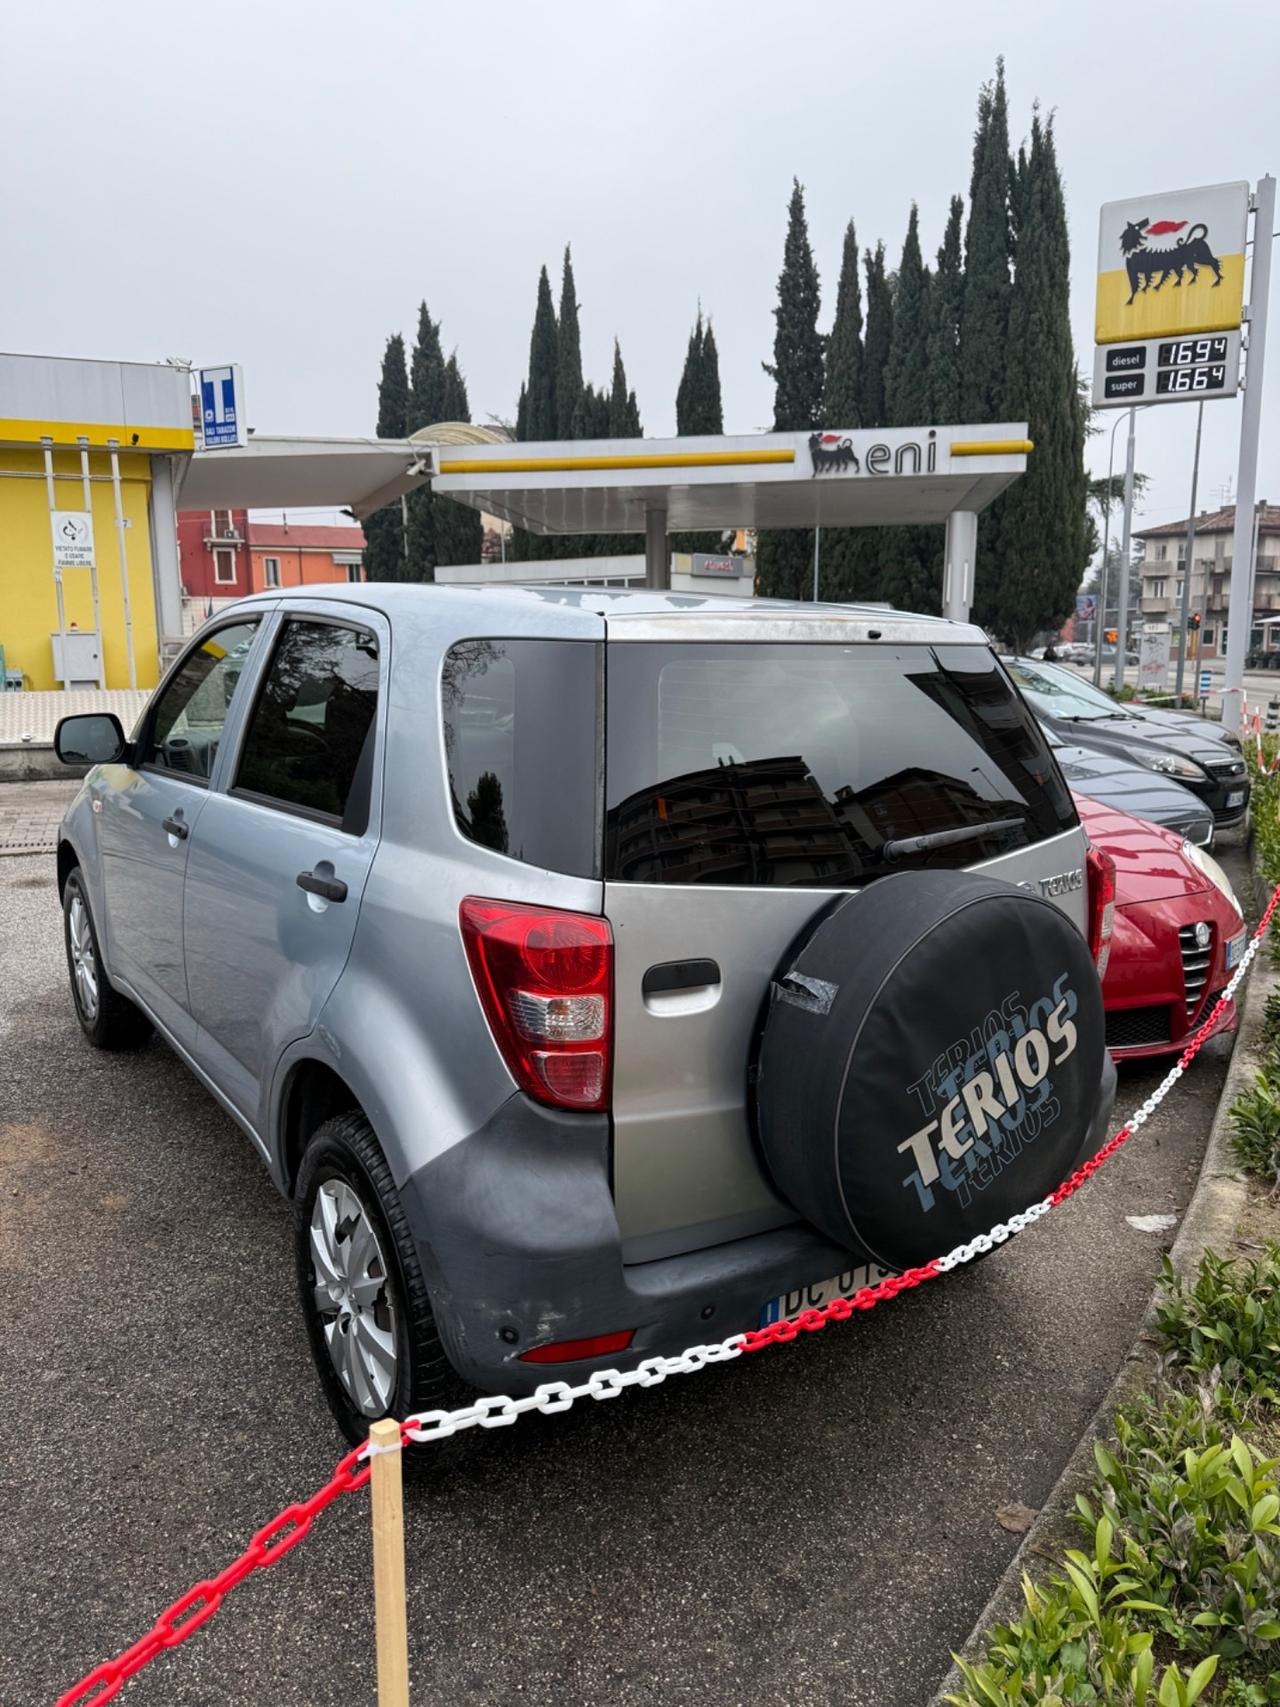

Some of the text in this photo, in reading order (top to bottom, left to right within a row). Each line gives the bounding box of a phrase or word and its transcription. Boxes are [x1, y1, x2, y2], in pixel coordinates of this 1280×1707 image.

[1112, 354, 1139, 366] diesel
[203, 368, 232, 424] T
[1111, 380, 1137, 392] super
[866, 430, 936, 475] eni
[1038, 869, 1083, 897] TERIOS
[897, 998, 1078, 1187] TERIOS
